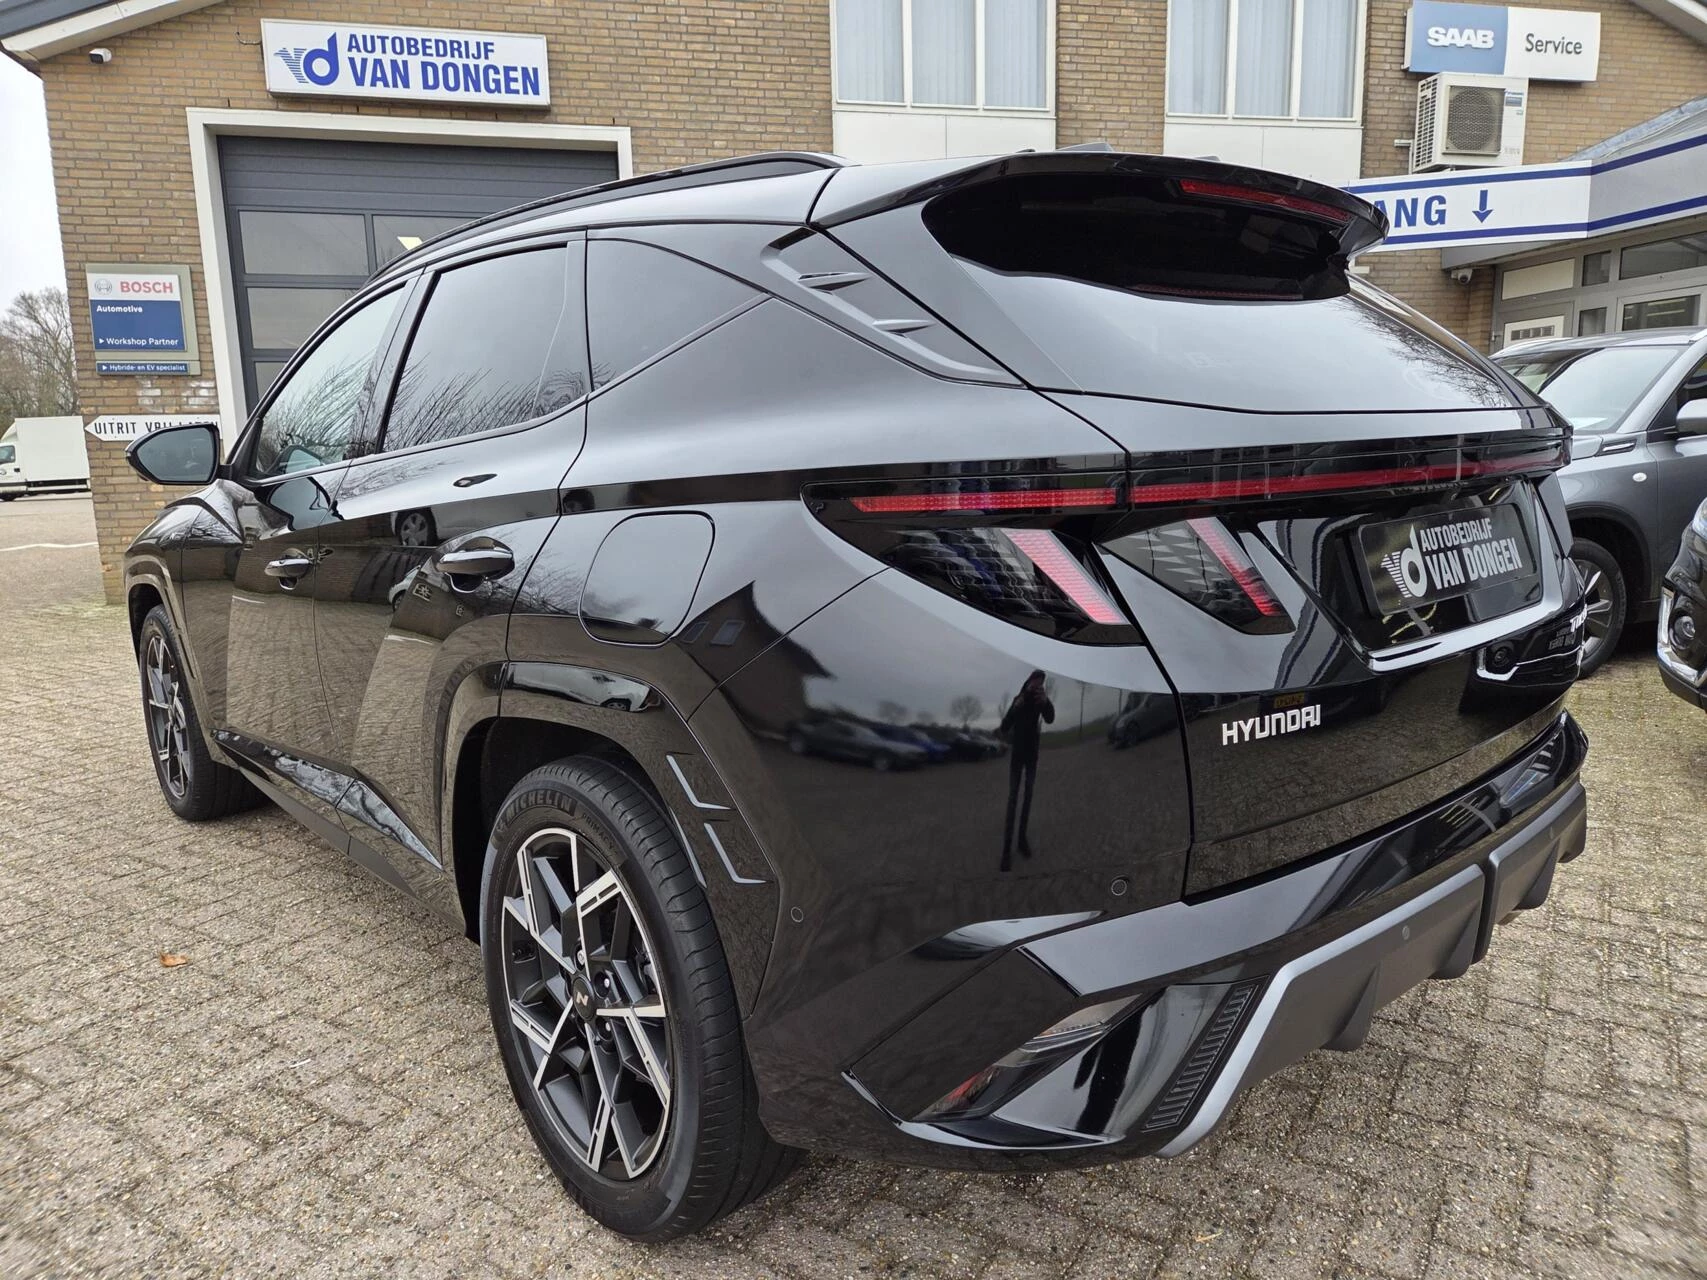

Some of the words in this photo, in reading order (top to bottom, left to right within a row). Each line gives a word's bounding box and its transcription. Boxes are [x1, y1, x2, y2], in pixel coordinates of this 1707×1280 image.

[347, 34, 494, 60] AUTOBEDRIJF
[1427, 26, 1494, 49] SAAB
[1525, 33, 1583, 55] Service
[347, 57, 410, 89] VAN
[421, 61, 540, 96] DONGEN
[120, 281, 173, 294] BOSCH
[96, 305, 143, 313] Automotive
[106, 337, 147, 346] Workshop
[149, 337, 178, 346] Partner
[156, 364, 186, 372] specialist
[94, 422, 136, 434] UITRIT
[1420, 518, 1492, 551] AUTOBEDRIJF
[1425, 549, 1466, 590] VAN
[1462, 537, 1522, 581] DONGEN
[1222, 704, 1321, 746] HYUNDAI
[505, 789, 571, 819] MICHELIN
